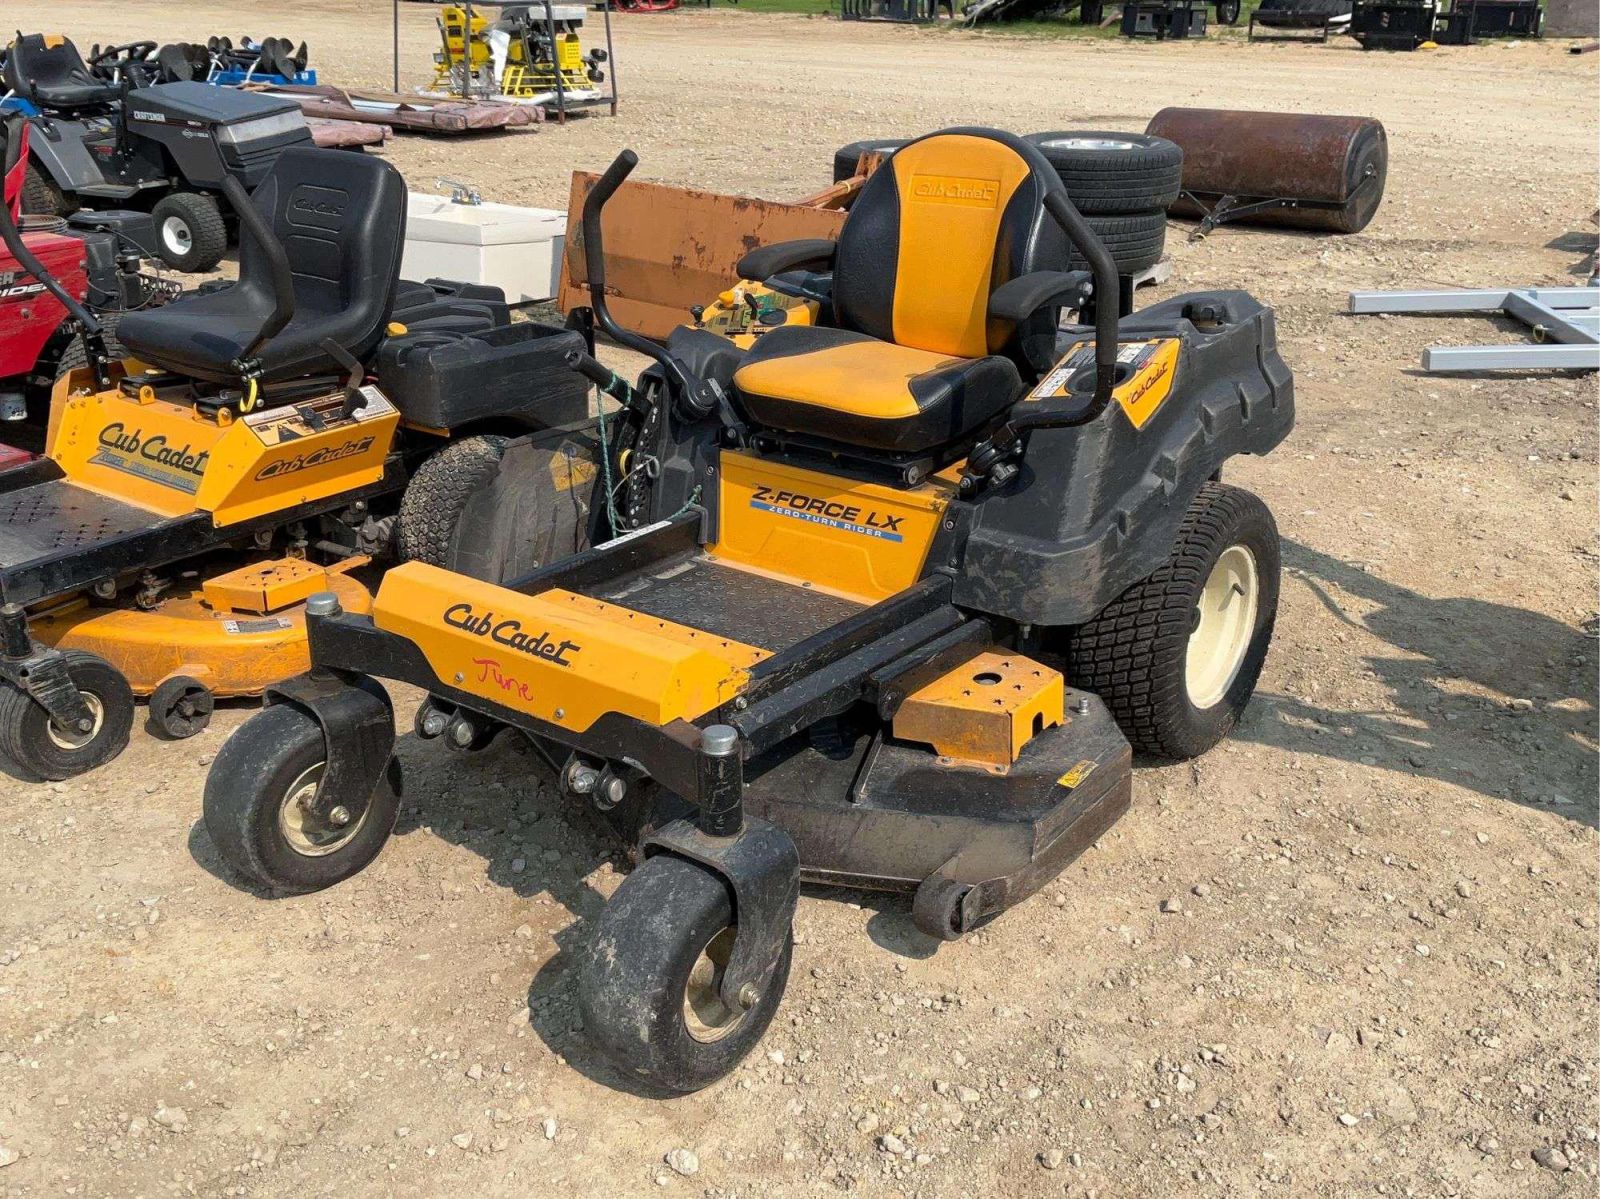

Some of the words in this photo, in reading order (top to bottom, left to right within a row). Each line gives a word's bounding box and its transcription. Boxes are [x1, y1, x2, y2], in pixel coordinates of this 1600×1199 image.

[915, 183, 944, 197] Cub
[944, 184, 994, 200] Cadet
[98, 422, 142, 454] Cub
[140, 435, 210, 477] Cadet
[254, 454, 304, 481] Cub
[302, 436, 376, 469] Cadet
[752, 486, 861, 522] Z-FORCE
[864, 511, 904, 532] LX
[768, 505, 838, 527] ZERO-TURN
[843, 522, 882, 538] RIDER
[443, 603, 493, 637] Cub
[491, 620, 582, 667] Cadet
